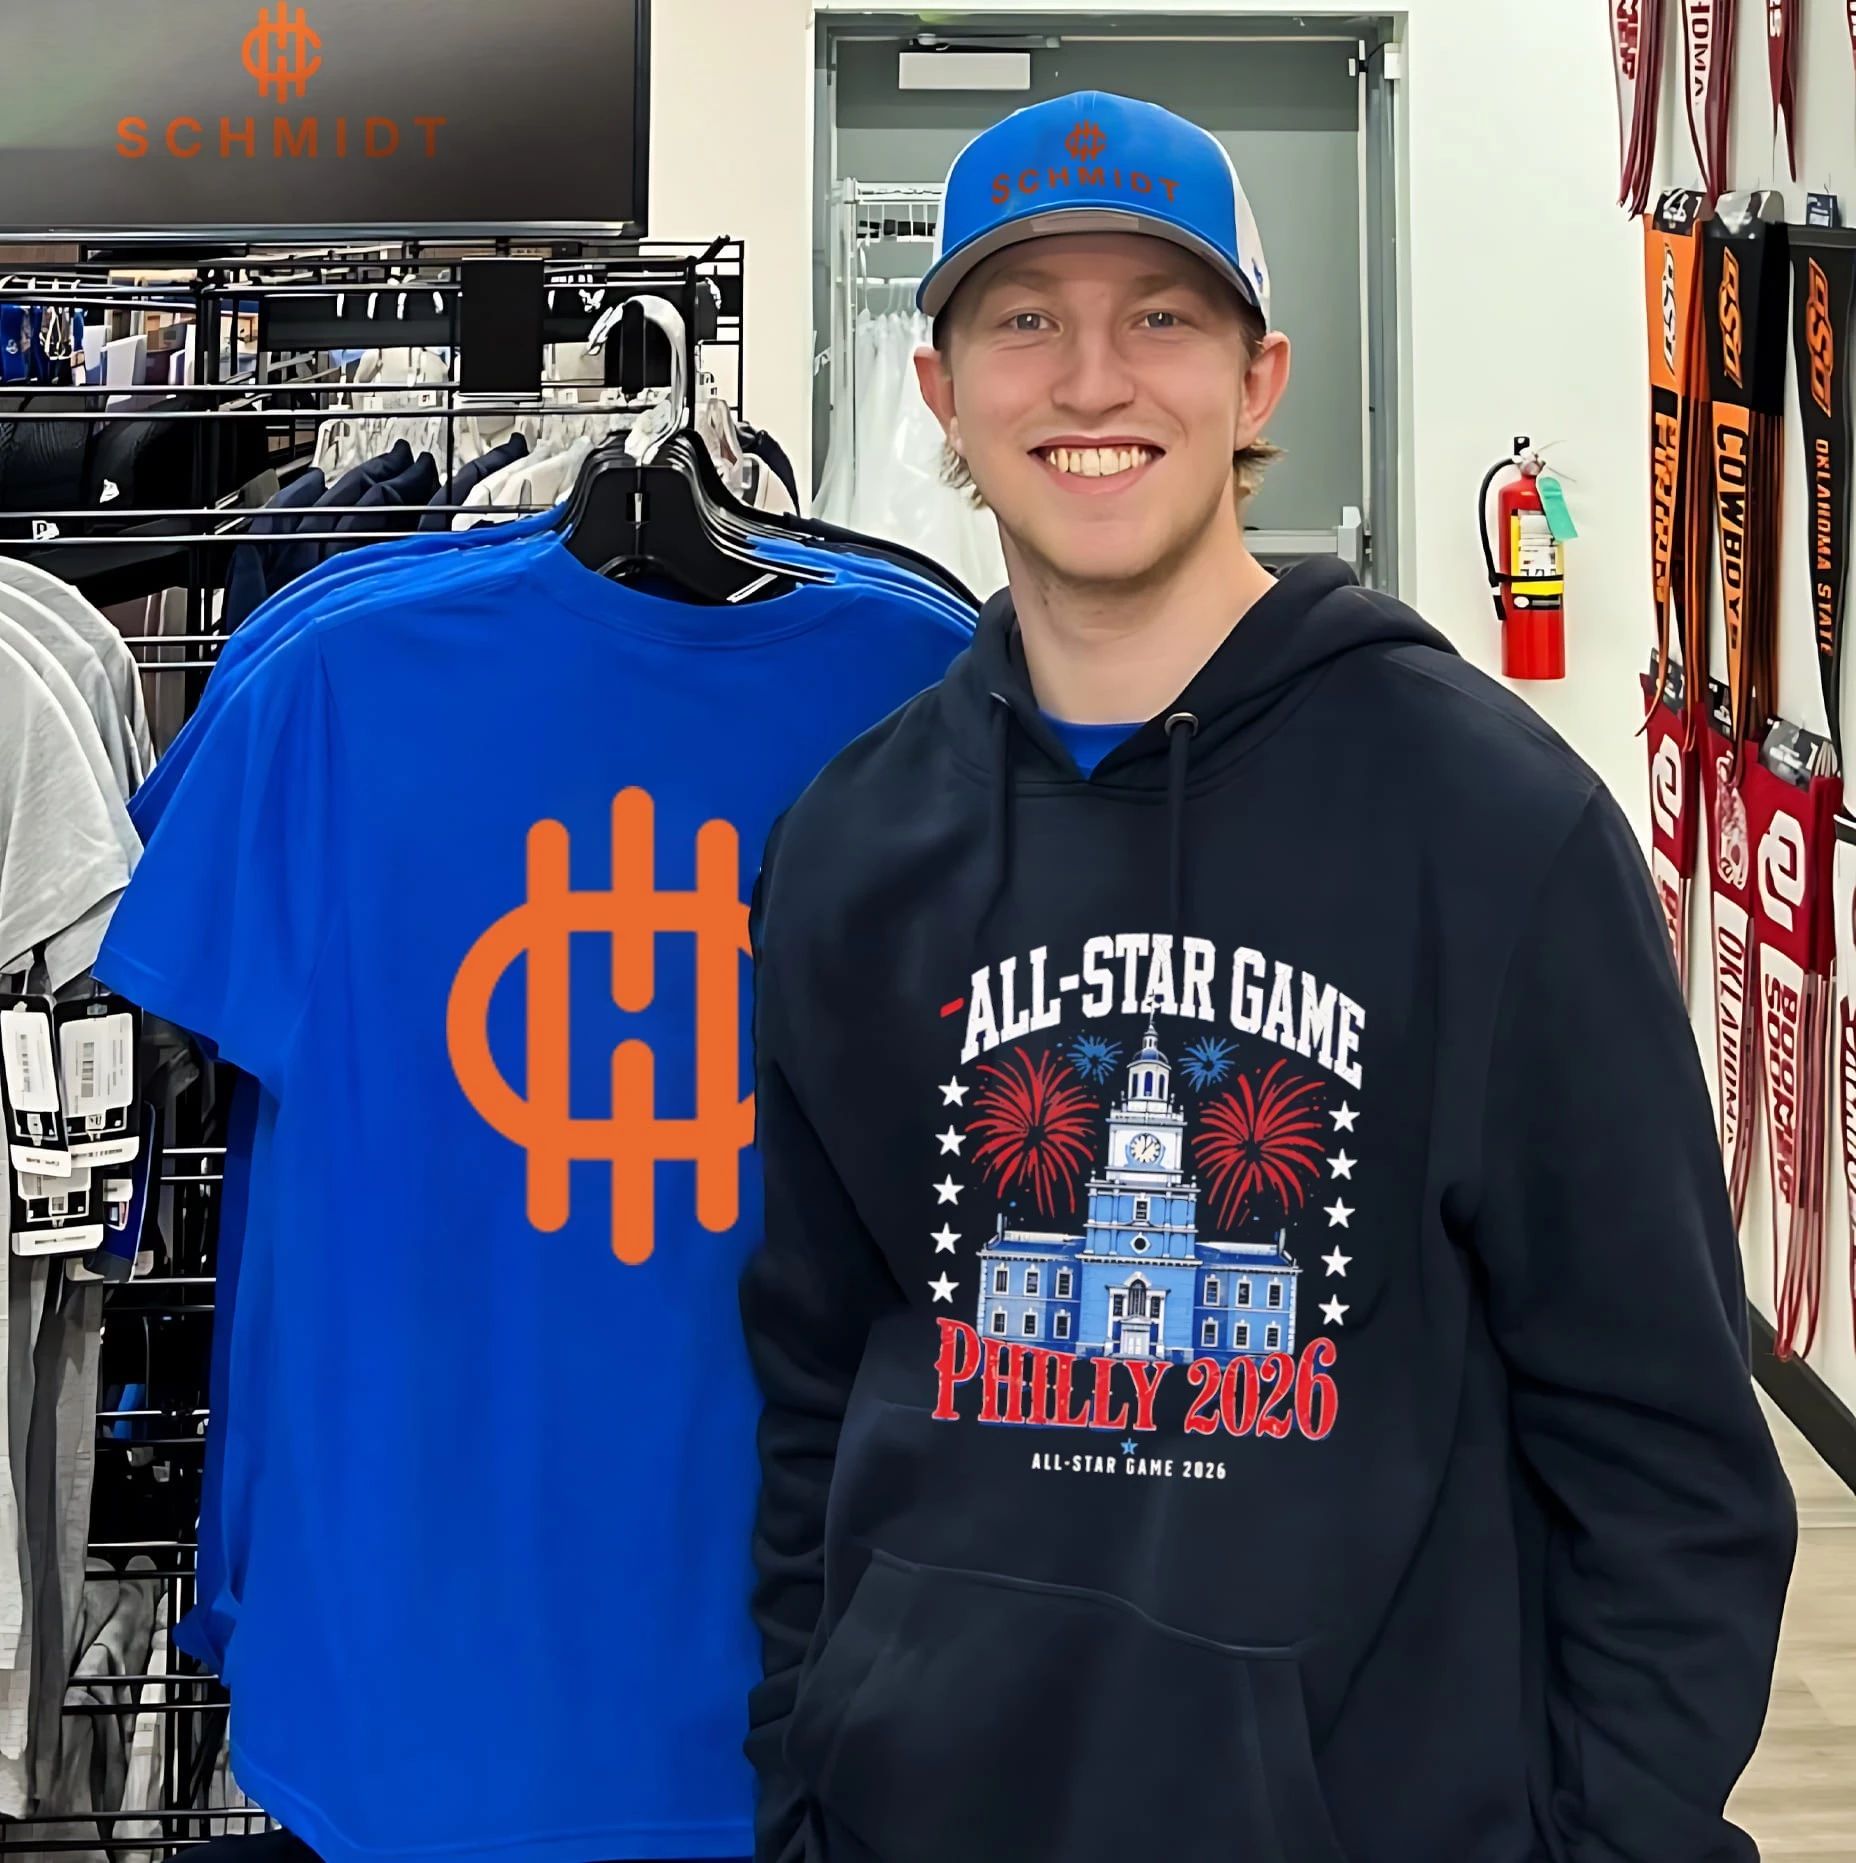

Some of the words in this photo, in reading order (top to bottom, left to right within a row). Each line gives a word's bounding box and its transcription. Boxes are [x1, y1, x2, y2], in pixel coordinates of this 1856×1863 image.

[115, 116, 448, 159] SCHMIDT
[992, 167, 1180, 204] SCHMIDT
[1815, 439, 1832, 570] OKLAHOMA
[961, 933, 1215, 1064] ALL-STAR
[1229, 946, 1366, 1090] GAME
[1719, 926, 1746, 1143] OKLAHOMA
[932, 1317, 1173, 1432] PHILLY
[1184, 1337, 1339, 1440] 2026
[1031, 1452, 1117, 1475] ALL-STAR
[1126, 1458, 1174, 1478] GAME
[1182, 1461, 1227, 1480] 2026
